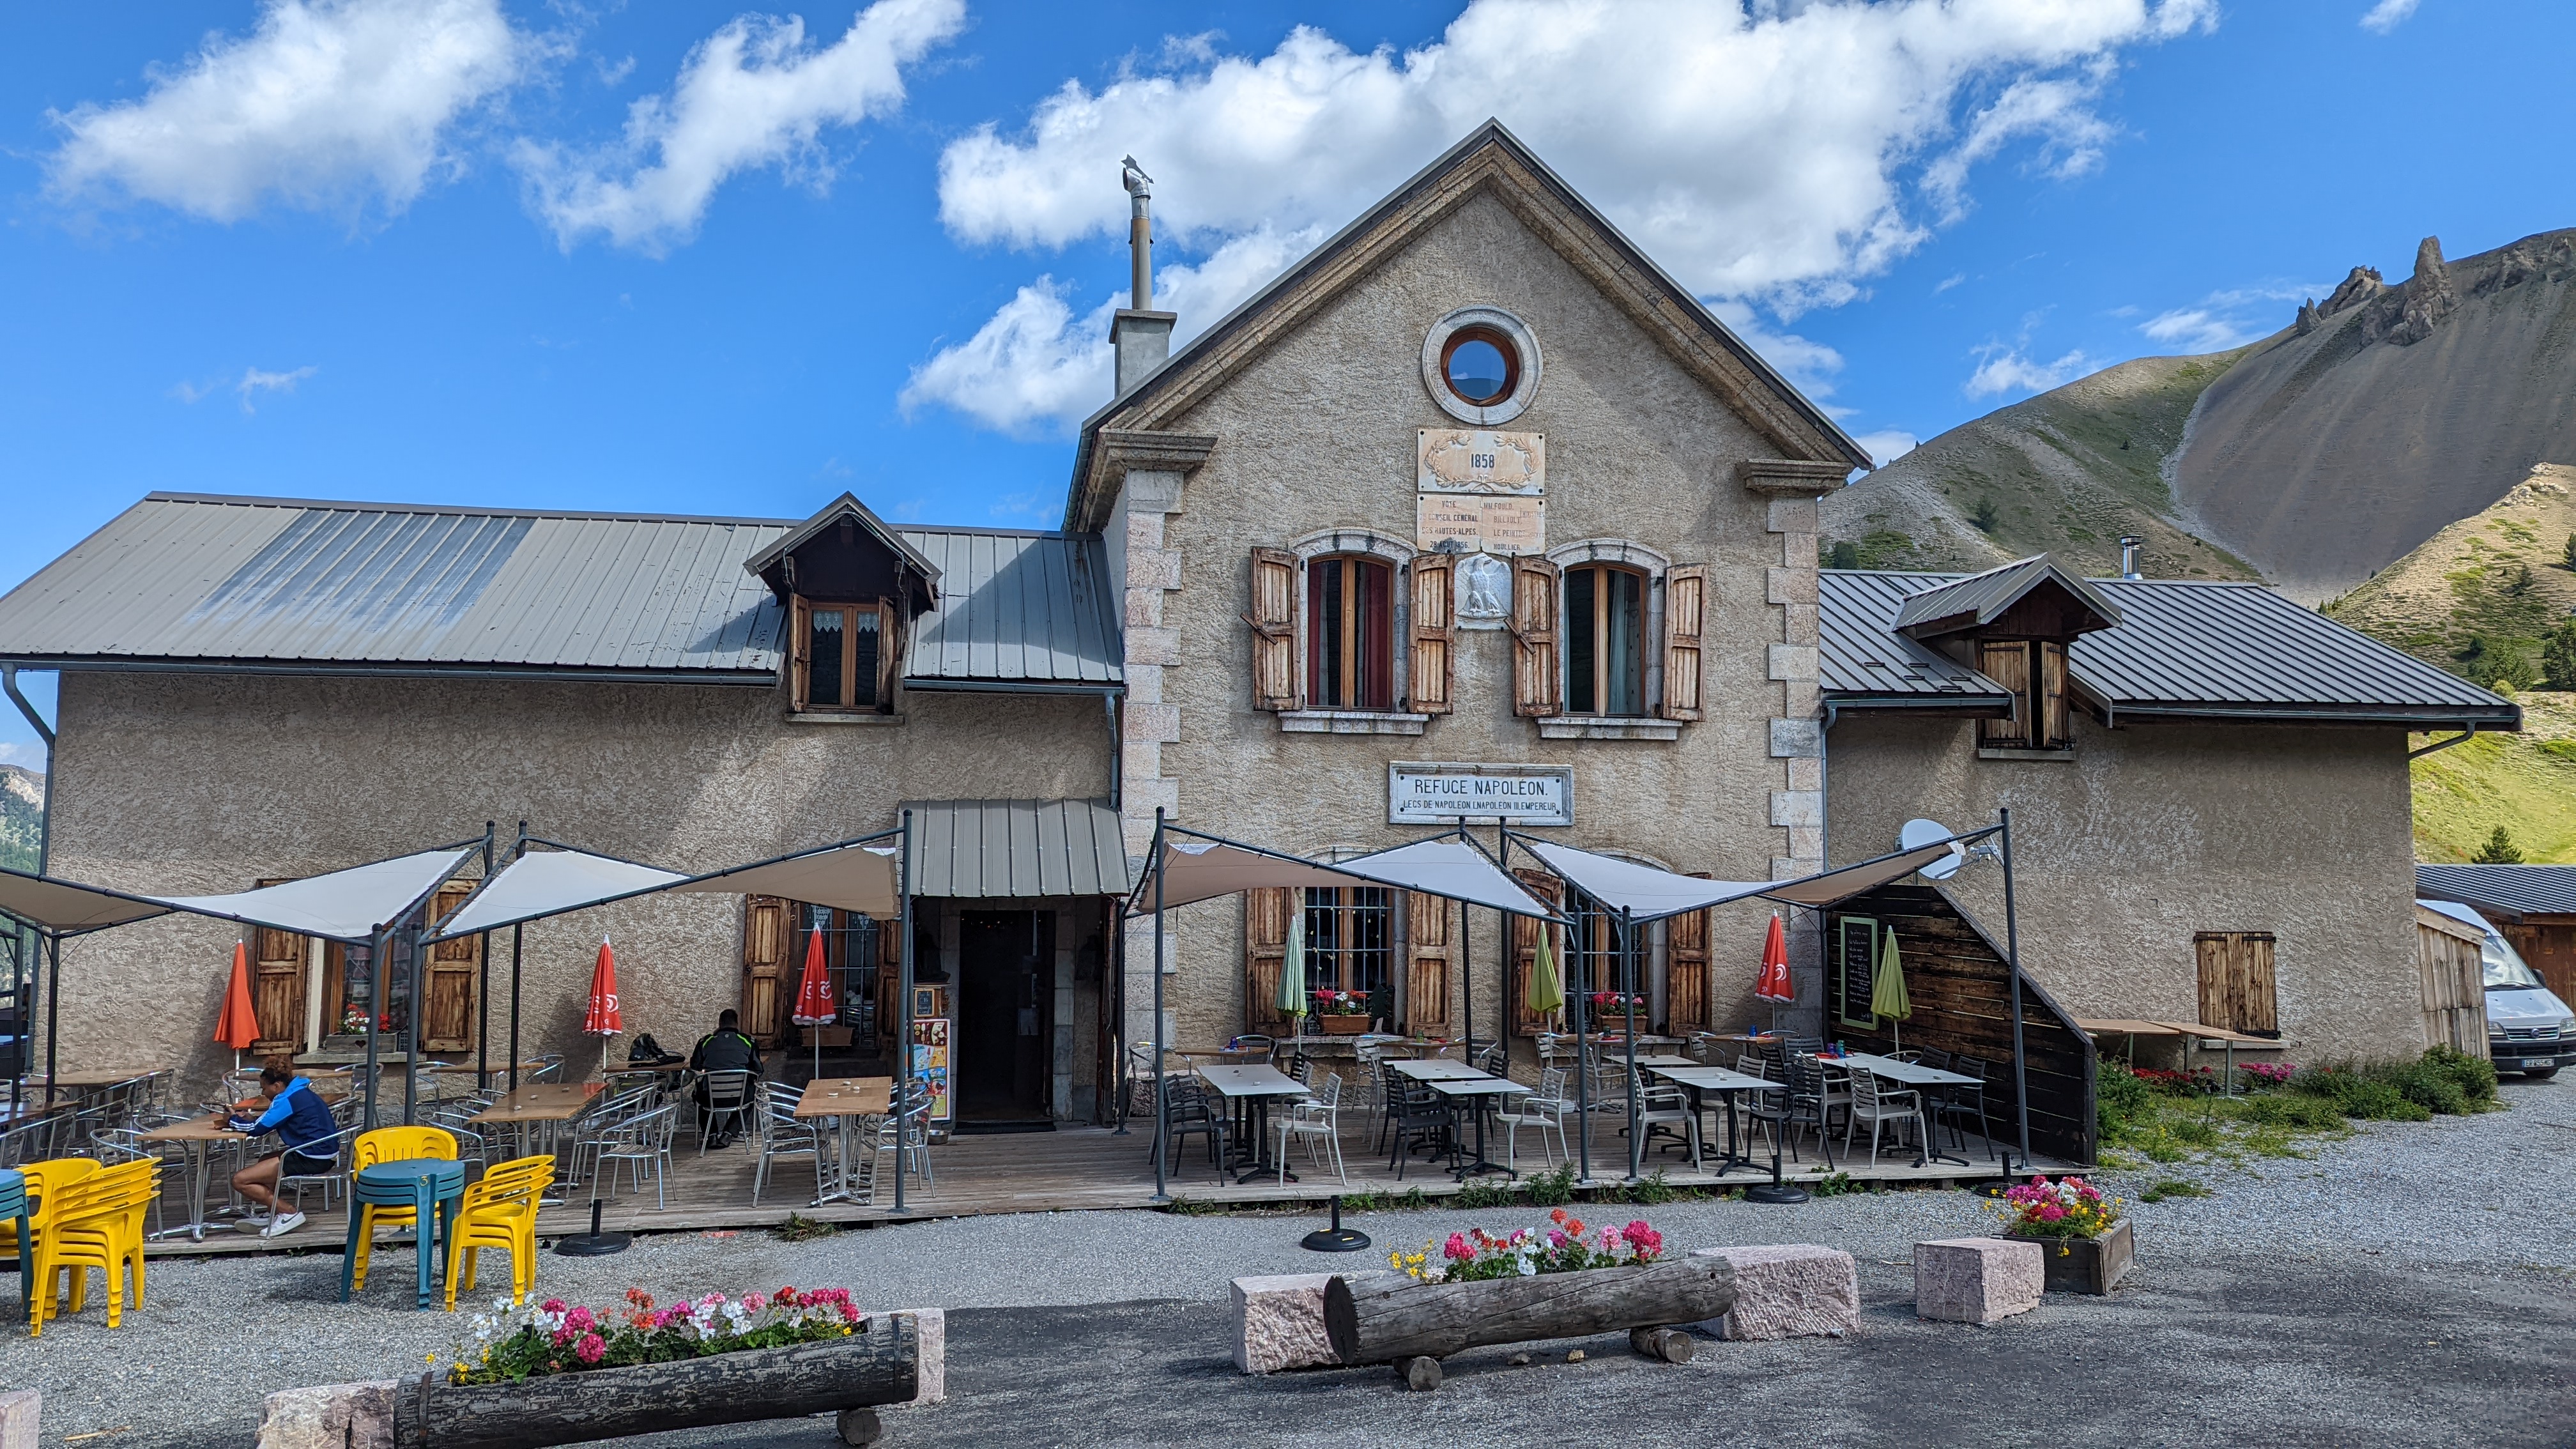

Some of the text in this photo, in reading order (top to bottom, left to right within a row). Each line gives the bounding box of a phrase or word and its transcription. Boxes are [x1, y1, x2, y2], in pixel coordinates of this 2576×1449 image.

[1471, 454, 1494, 468] 1858
[1434, 527, 1478, 536] HAUTES-ALPES.
[1414, 779, 1548, 796] REFUGE NAPOLÉON.
[1423, 800, 1433, 809] DE
[420, 1176, 429, 1186] 3
